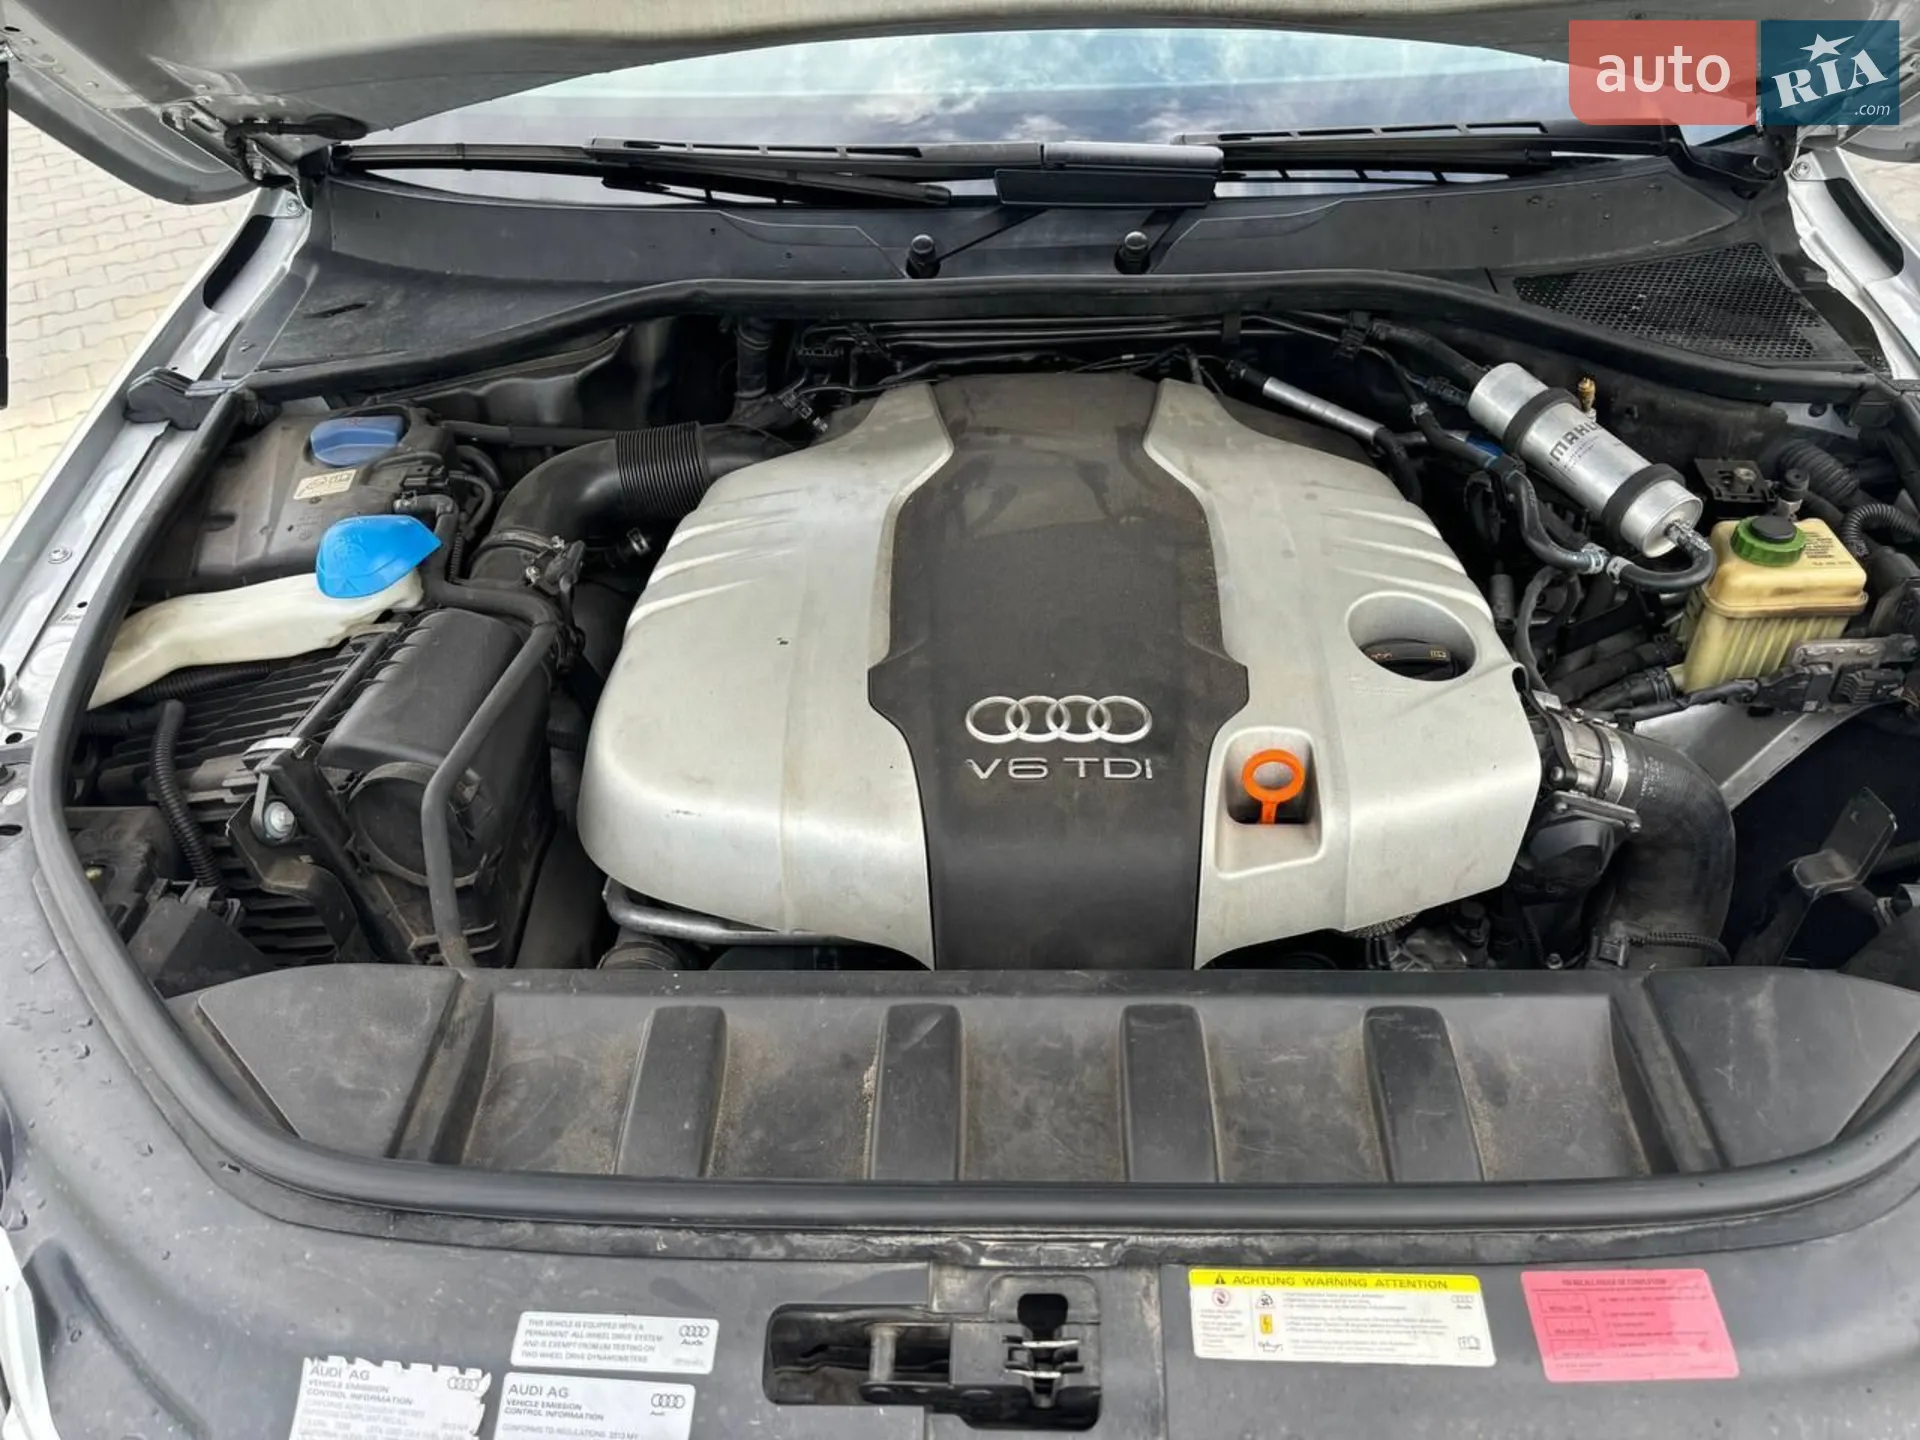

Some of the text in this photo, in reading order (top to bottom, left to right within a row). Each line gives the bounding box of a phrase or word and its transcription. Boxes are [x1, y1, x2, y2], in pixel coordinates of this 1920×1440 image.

[965, 757, 1153, 779] V6 TDI
[1232, 1275, 1448, 1289] ACHTUNG WARNING ATTENTION
[546, 1320, 572, 1328] VEHICLE
[310, 1367, 371, 1381] AUDI AG
[308, 1380, 389, 1393] VEHICLE EMISSION
[508, 1383, 570, 1398] AUDI AG
[306, 1388, 413, 1405] CONTROL INFORMATION
[507, 1399, 583, 1411] VEHICLE EMISSION
[504, 1407, 604, 1421] CONTROL INFORMATION
